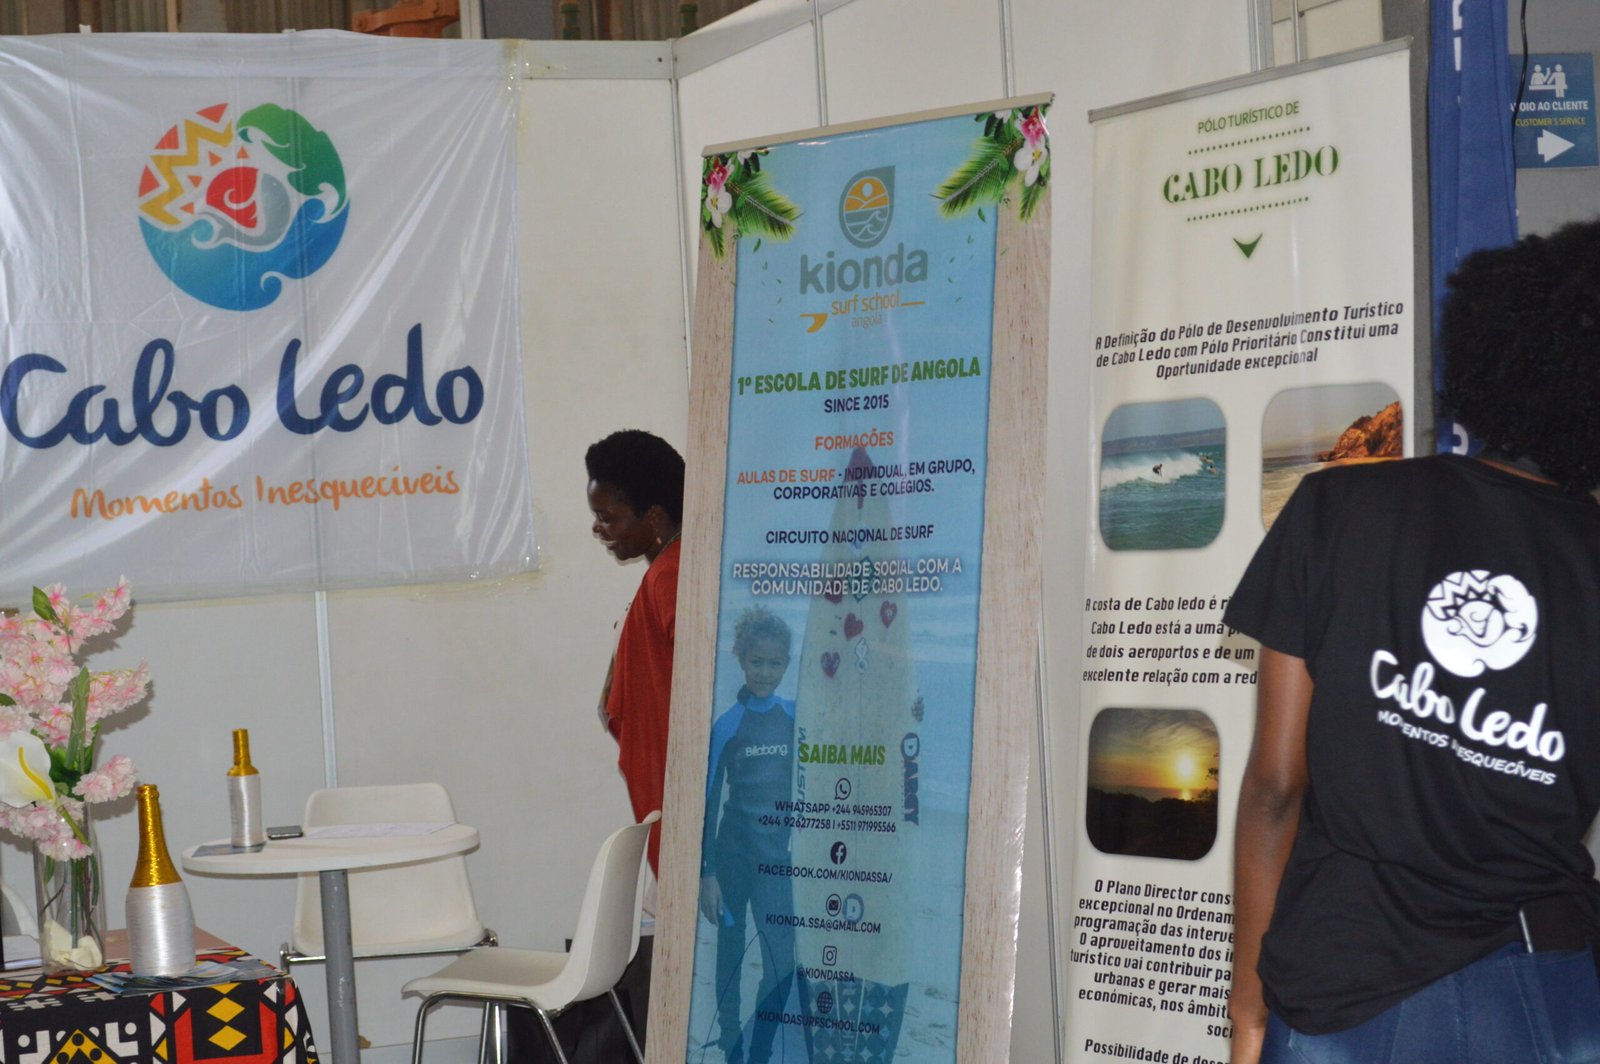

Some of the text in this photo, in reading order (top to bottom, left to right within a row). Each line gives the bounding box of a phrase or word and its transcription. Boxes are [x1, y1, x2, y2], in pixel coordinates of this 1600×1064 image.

[1537, 101, 1550, 111] AO
[1552, 100, 1589, 111] CLIENTE
[1198, 101, 1300, 134] PÓLO TURÍSTICO DE
[1163, 145, 1339, 204] CABO LEDO
[800, 242, 928, 295] kionda
[831, 289, 901, 315] surf school
[851, 313, 883, 329] angola
[1095, 301, 1404, 350] A Definição do Pólo de Desenvolvimento Turístico
[1096, 322, 1399, 368] de Cabo Ledo com Pólo Prioritário Constitui uma
[1156, 347, 1319, 380] Oportunidade excepcional
[0, 322, 485, 449] Cabo Ledo
[755, 371, 821, 395] ESCOLA
[825, 369, 847, 390] DE
[849, 366, 888, 388] SURF
[891, 363, 908, 384] DE
[910, 357, 981, 382] ANGOLA
[824, 394, 889, 413] SINCE 2015
[815, 428, 894, 451] FORMAÇÕES
[737, 470, 775, 484] AULAS
[779, 469, 796, 483] DE
[801, 468, 836, 482] SURF
[909, 461, 925, 475] EM
[928, 458, 975, 475] GRUPO,
[70, 465, 461, 520] Momentos Inesquecíveis
[774, 484, 867, 500] CORPORATIVAS
[870, 483, 877, 497] E
[766, 525, 934, 544] CIRCUITO NACIONAL DE SURF
[732, 558, 962, 578] RESPONSABILIDADE SOCIAL COM A
[752, 576, 943, 595] COMUNIDADE DE CABO LEDO.
[1092, 598, 1120, 611] costa
[1124, 597, 1142, 611] de
[1145, 597, 1174, 611] Cabo
[1177, 596, 1205, 610] ledo
[1209, 594, 1217, 610] é
[1091, 621, 1115, 635] Cabo
[1119, 621, 1152, 635] Ledo
[1155, 620, 1181, 635] está
[1184, 623, 1192, 635] a
[1195, 623, 1224, 635] uma
[1086, 645, 1097, 658] de
[1099, 645, 1124, 658] dois
[1128, 646, 1199, 661] aeroportos
[1203, 648, 1210, 659] e
[1214, 646, 1231, 659] de
[1082, 668, 1139, 682] excelente
[1142, 667, 1188, 686] relação
[1192, 672, 1219, 684] com
[1223, 672, 1231, 684] a
[1370, 650, 1565, 762] Cabo Ledo
[799, 743, 886, 765] SAIBA MAIS
[775, 801, 830, 814] WHATSAPP
[832, 804, 850, 815] +244
[758, 815, 781, 826] +244
[784, 816, 830, 830] 926277258
[837, 821, 856, 831] +5511
[758, 864, 892, 884] FACEBOOK.COM/KIONDASSA/
[1094, 879, 1103, 893] O
[1106, 880, 1141, 896] Plano
[1144, 883, 1198, 902] Director
[1078, 898, 1154, 916] excepcional
[1157, 905, 1173, 918] no
[766, 913, 881, 934] KIONDA.SSA@GMAIL.COM
[1074, 915, 1157, 936] programação
[1160, 922, 1183, 937] das
[1079, 932, 1087, 946] O
[1090, 934, 1195, 958] aproveitamento
[1198, 945, 1221, 962] dos
[1070, 947, 1121, 967] turístico
[1123, 956, 1143, 970] vai
[1146, 958, 1213, 980] contribuir
[1094, 971, 1232, 1000] urbanas e gerar mais
[1078, 987, 1156, 1011] económicas,
[1160, 999, 1184, 1013] nos
[758, 1010, 880, 1034] KIONDASURFSCHOOL.COM
[1084, 1038, 1169, 1064] Possibilidade
